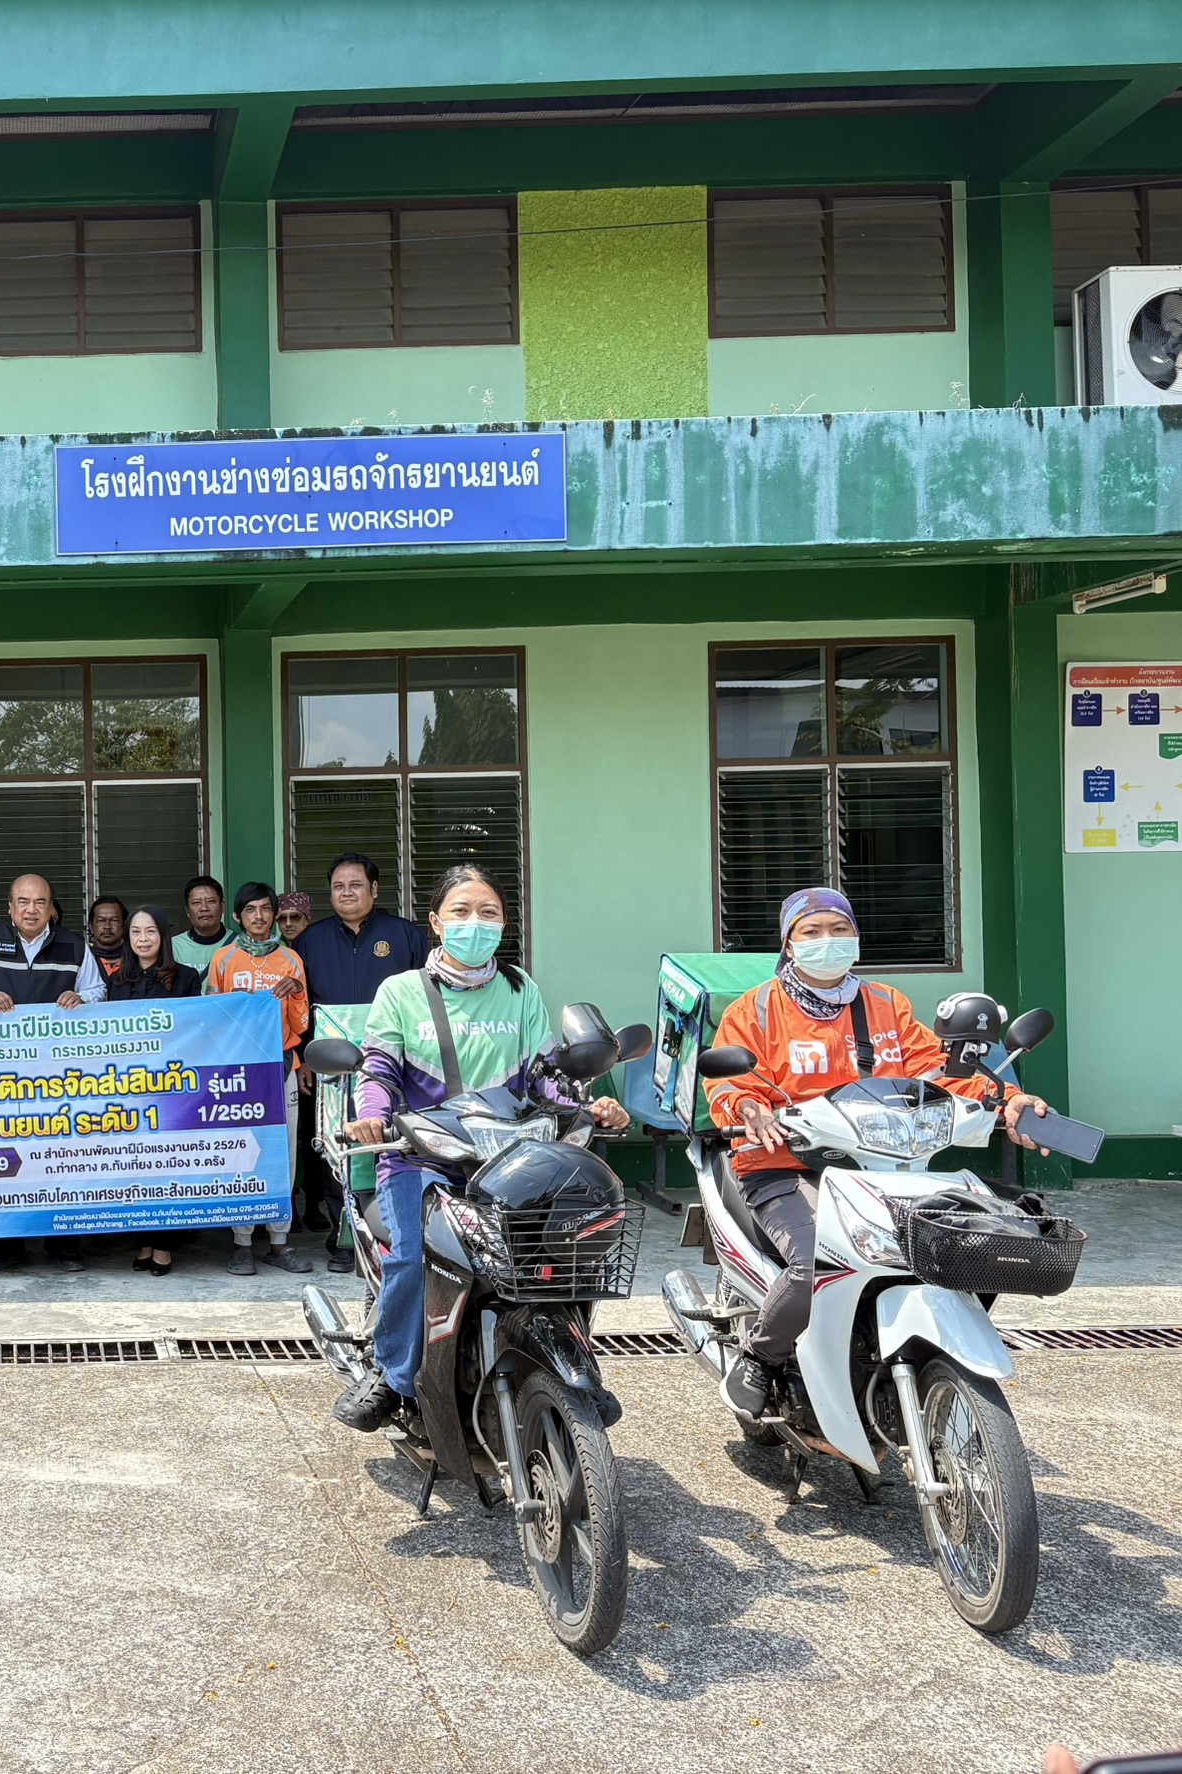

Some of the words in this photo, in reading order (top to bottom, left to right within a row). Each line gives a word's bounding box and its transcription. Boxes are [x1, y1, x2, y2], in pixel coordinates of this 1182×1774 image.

[81, 448, 540, 499] โรงฝึกงานช่างซ่อมรถจักรยานยนต์
[169, 512, 319, 537] MOTORCYCLE
[327, 508, 455, 532] WORKSHOP
[254, 970, 283, 980] Shope
[51, 1039, 161, 1058] กระทรวงแรงงาน
[207, 1066, 247, 1100] รุ่นที่
[76, 1105, 138, 1134] ระดับ
[145, 1107, 158, 1130] 1
[197, 1102, 265, 1122] 1/2569
[29, 1150, 42, 1160] ณ
[44, 1139, 211, 1159] สำนักงานพัฒนาฝีมือแรงงานตรัง
[213, 1139, 247, 1150] 252/6
[45, 1161, 98, 1175] ถ.ท่ากลาง
[100, 1155, 152, 1172] ต.ทับเที่ยง
[155, 1157, 191, 1169] อ.เมือง
[193, 1156, 225, 1168] จ.ตรัง
[73, 1220, 123, 1230] dsd.go.th/trang
[127, 1219, 160, 1227] Facebook
[818, 1240, 850, 1265] HONDA
[997, 1256, 1032, 1264] HONDA
[430, 1262, 463, 1285] HONDA
